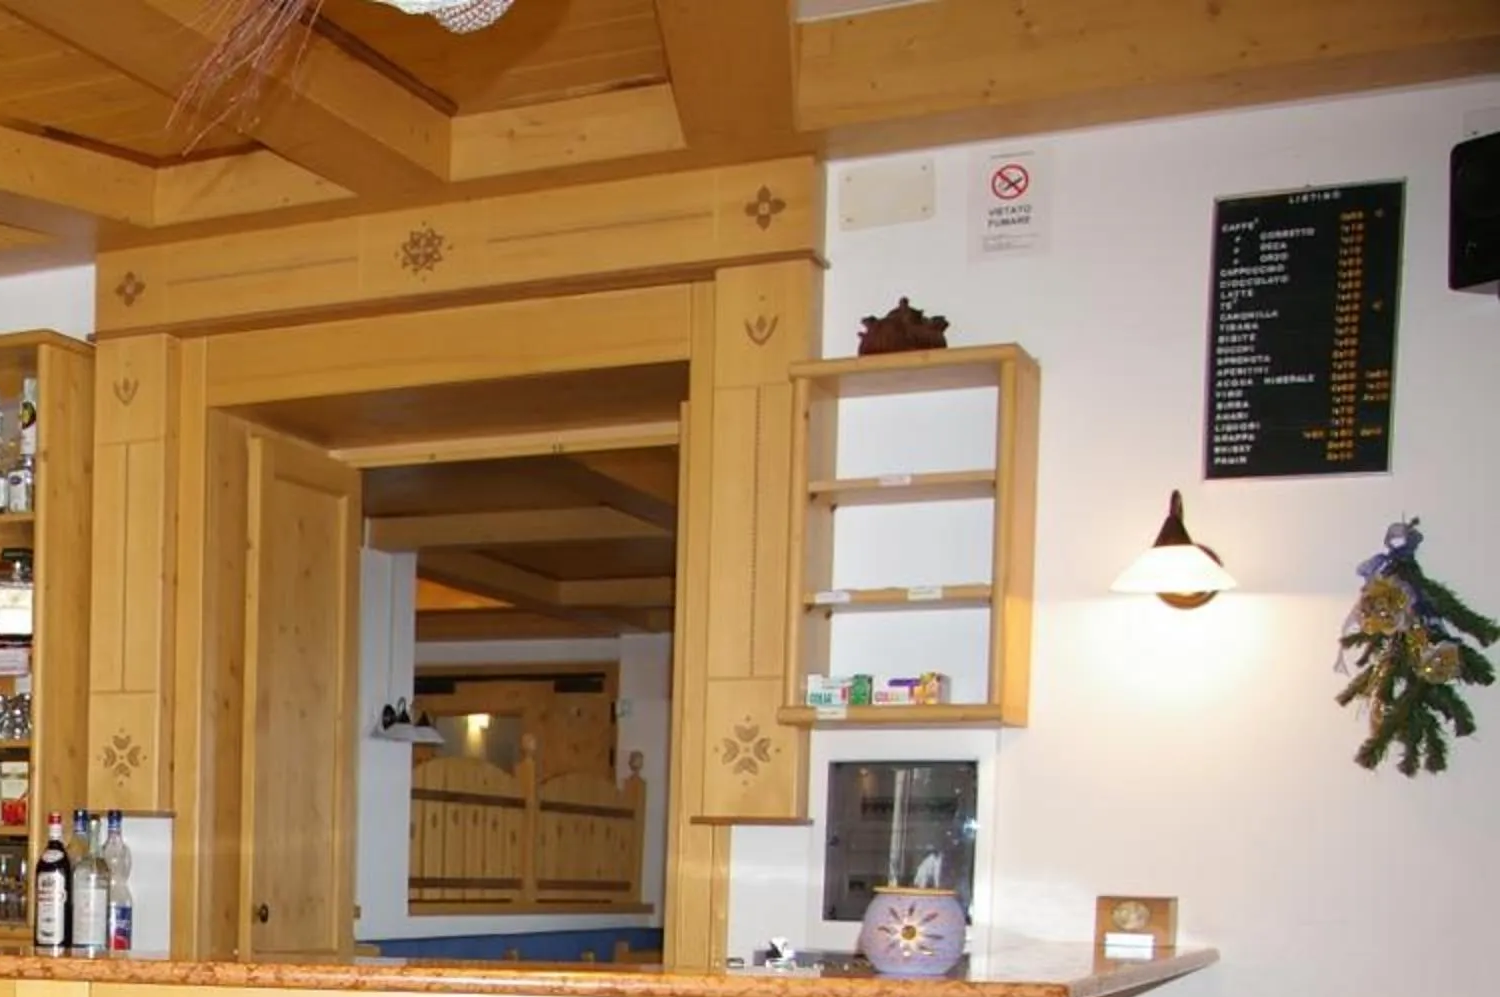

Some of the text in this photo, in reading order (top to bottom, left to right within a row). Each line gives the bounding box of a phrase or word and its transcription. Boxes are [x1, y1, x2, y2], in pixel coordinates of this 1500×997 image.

[988, 204, 1032, 216] VIETATO
[988, 216, 1031, 227] FUMARE
[1219, 263, 1285, 277] CAPPUCCINO
[1219, 288, 1253, 298] LATTE
[1217, 333, 1256, 343] BIBITE
[1215, 373, 1316, 387] ACQUA MINERALE
[1215, 389, 1243, 399] VINO
[1216, 400, 1249, 410] BIRRA
[1214, 421, 1260, 432] LIQUORI
